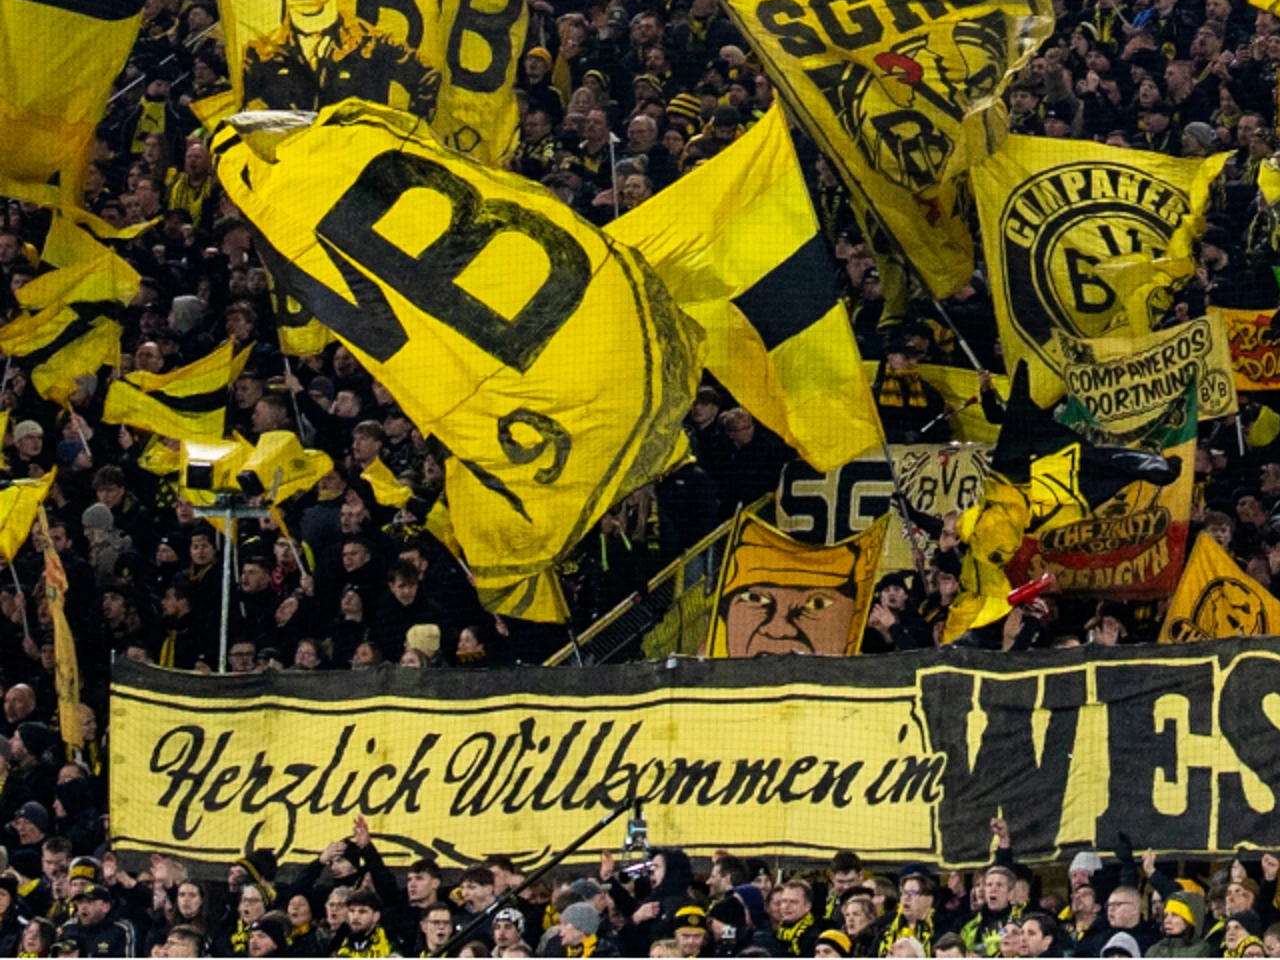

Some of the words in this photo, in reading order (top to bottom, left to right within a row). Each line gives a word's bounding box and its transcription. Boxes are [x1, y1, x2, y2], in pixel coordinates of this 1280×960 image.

[1067, 326, 1207, 395] COMPANEROS
[1086, 360, 1199, 417] DORTMUND
[1201, 372, 1229, 401] BVB
[149, 722, 441, 859] Herzlich
[444, 717, 856, 818] Willkommen
[863, 724, 945, 807] im
